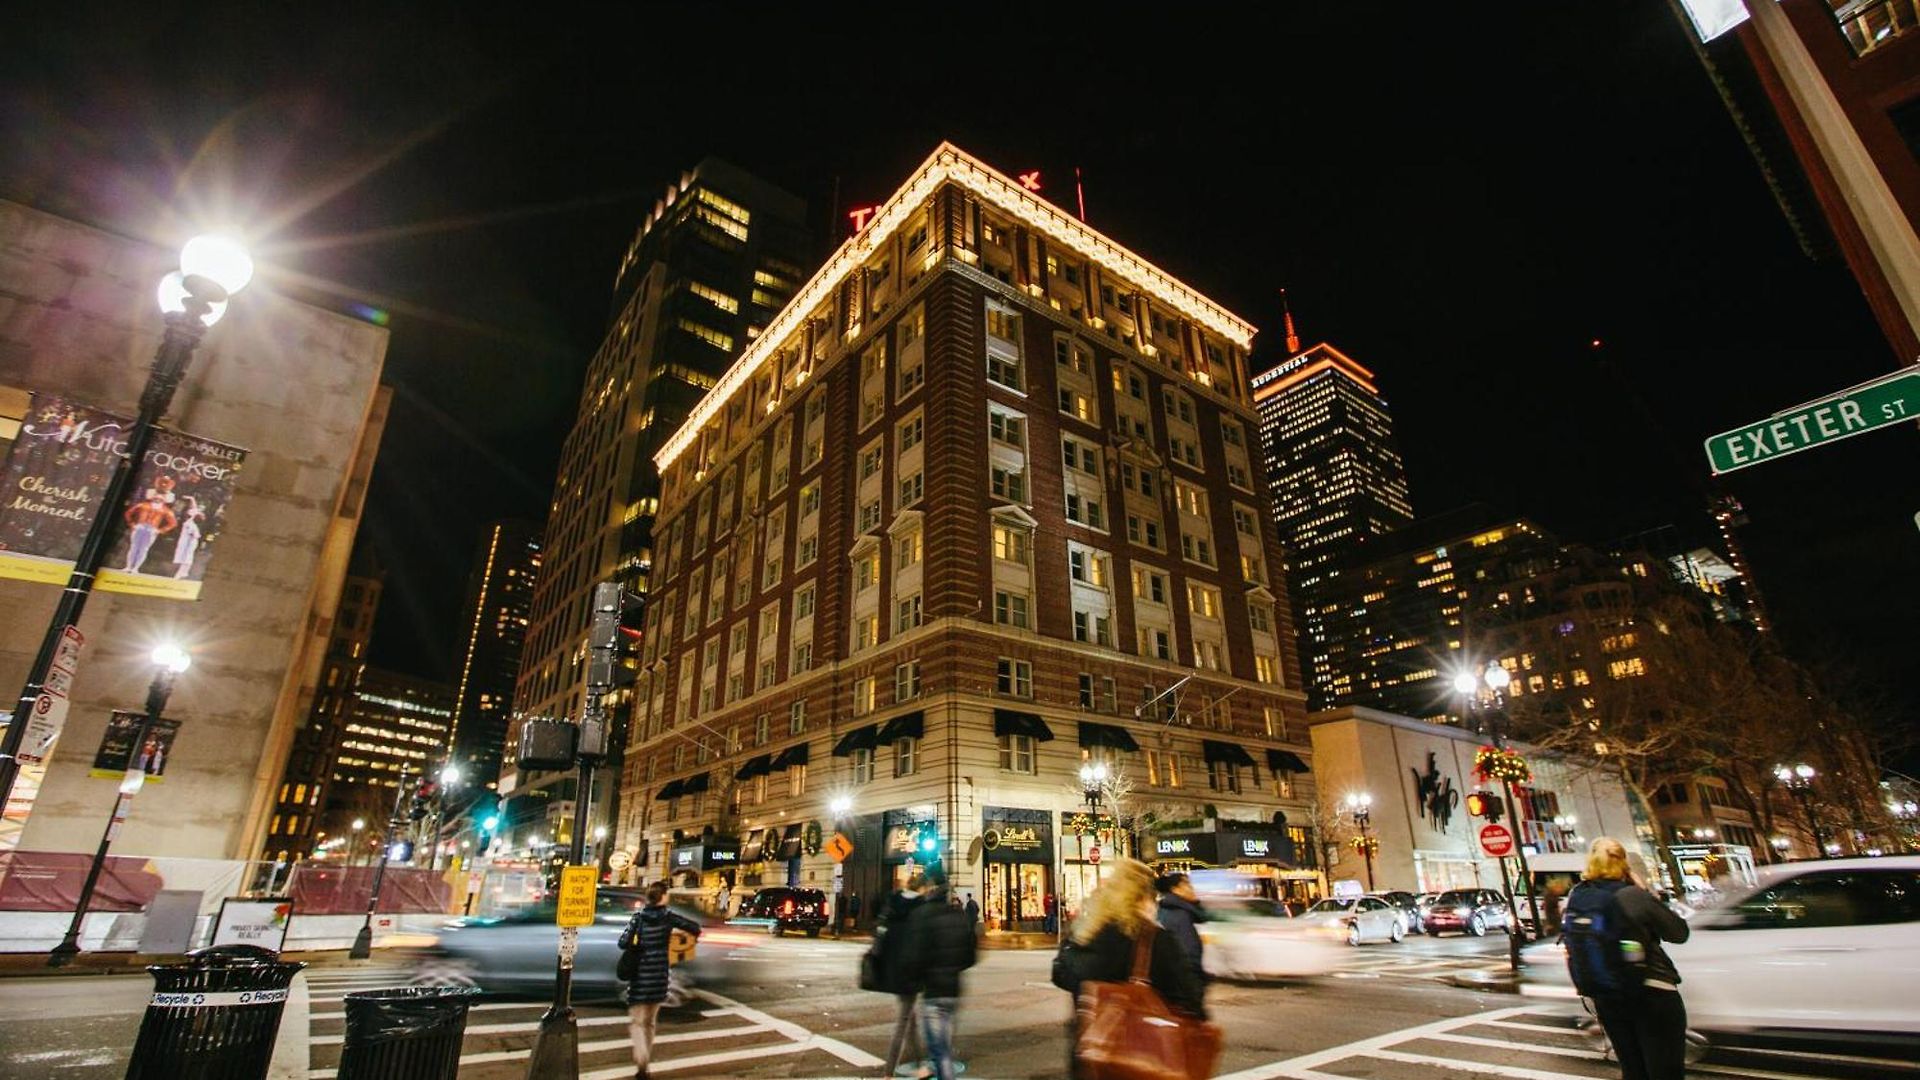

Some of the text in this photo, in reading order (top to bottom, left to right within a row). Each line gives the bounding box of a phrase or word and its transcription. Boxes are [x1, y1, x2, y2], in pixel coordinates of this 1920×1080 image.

[1251, 355, 1308, 389] RUDENTIAL
[1727, 400, 1905, 464] EXETER ST
[19, 476, 92, 503] Cherish
[1157, 840, 1190, 853] LENOX
[1243, 840, 1269, 852] LENOX
[572, 886, 584, 895] FOR
[156, 991, 190, 1005] Recycle
